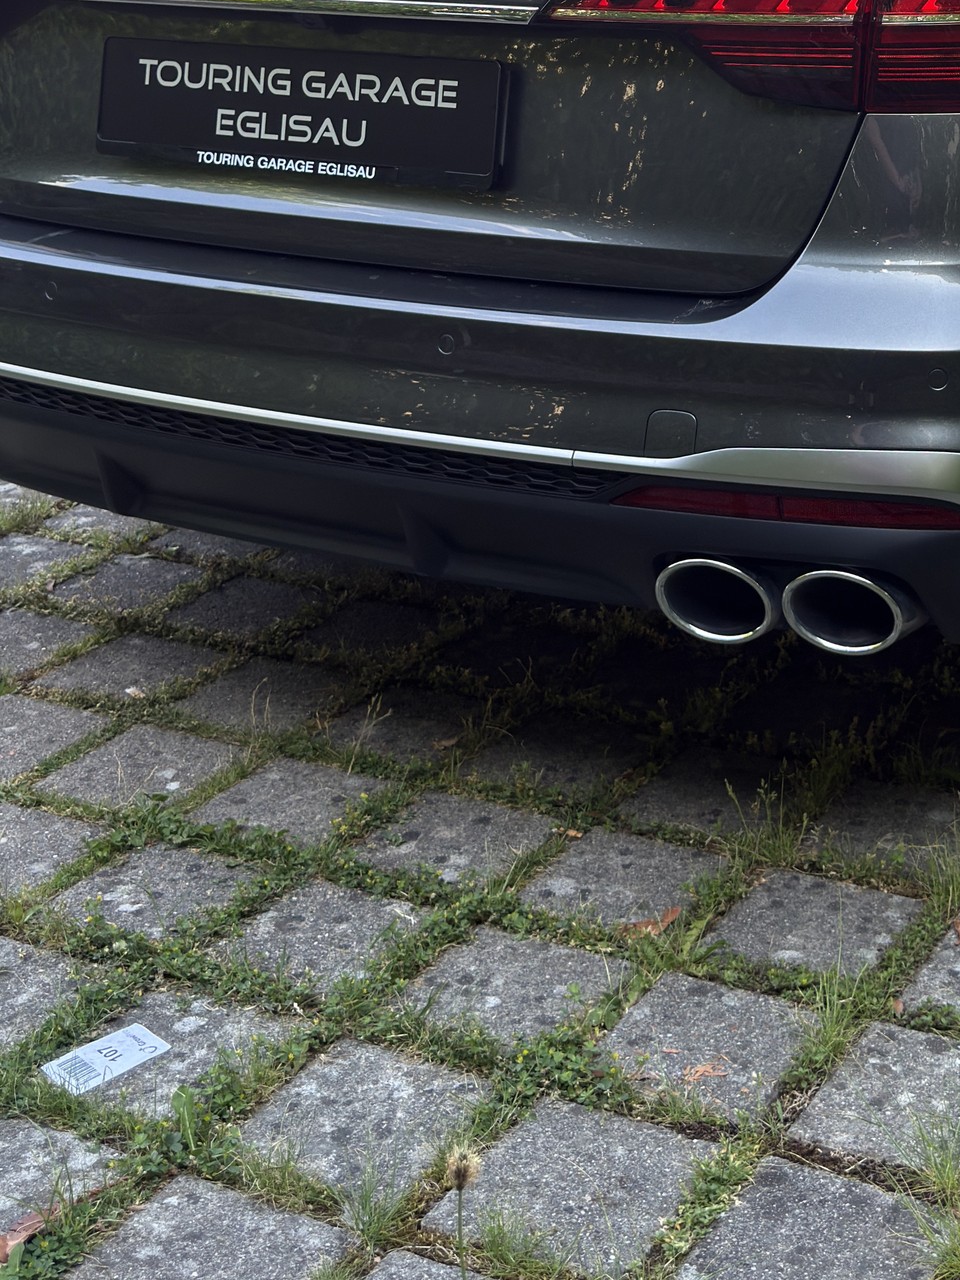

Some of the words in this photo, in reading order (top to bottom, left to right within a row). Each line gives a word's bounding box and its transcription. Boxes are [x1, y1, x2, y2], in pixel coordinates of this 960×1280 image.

[138, 57, 291, 96] TOURING
[301, 70, 459, 109] GARAGE
[215, 108, 367, 148] EGLISAU
[196, 150, 255, 169] TOURING
[257, 156, 315, 174] GARAGE
[317, 161, 376, 180] EGLISAU
[97, 1045, 123, 1062] 107
